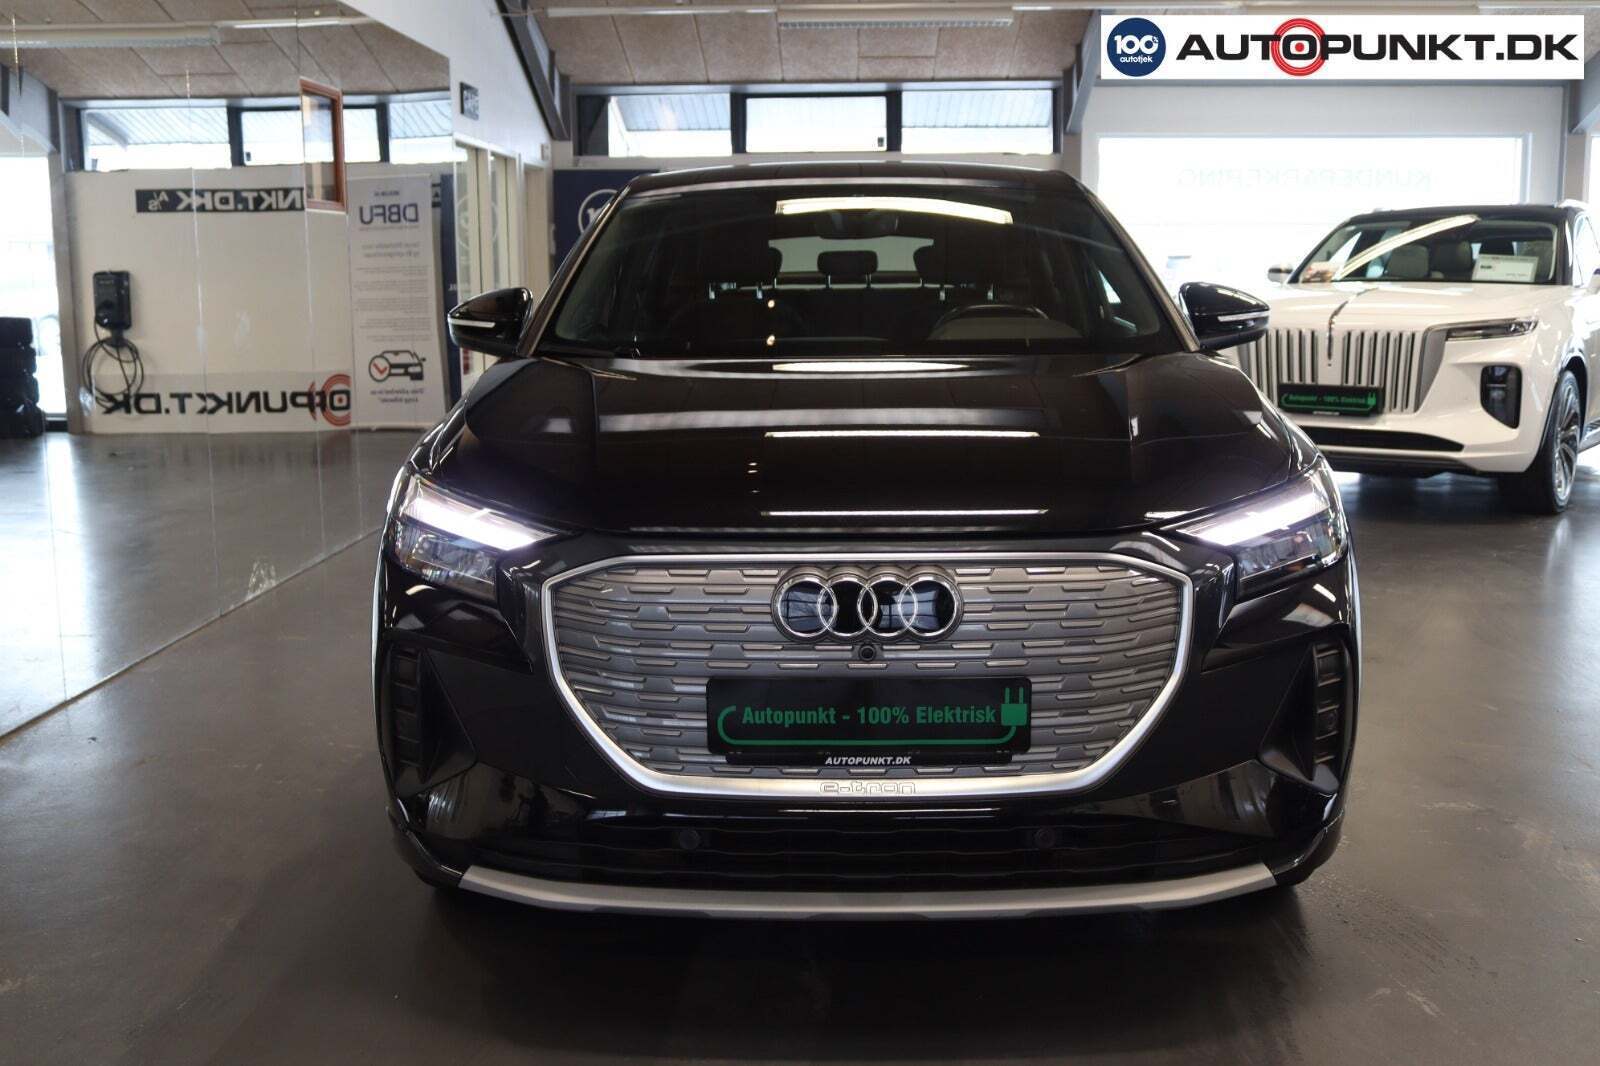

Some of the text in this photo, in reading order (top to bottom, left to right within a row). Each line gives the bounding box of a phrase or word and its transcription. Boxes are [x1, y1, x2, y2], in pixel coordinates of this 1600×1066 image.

[742, 706, 836, 728] Autopunkt
[857, 706, 909, 725] 100%
[916, 706, 996, 725] Elektrisk
[825, 756, 911, 766] AUTOPUNKT.DK
[819, 780, 916, 794] e-tron
